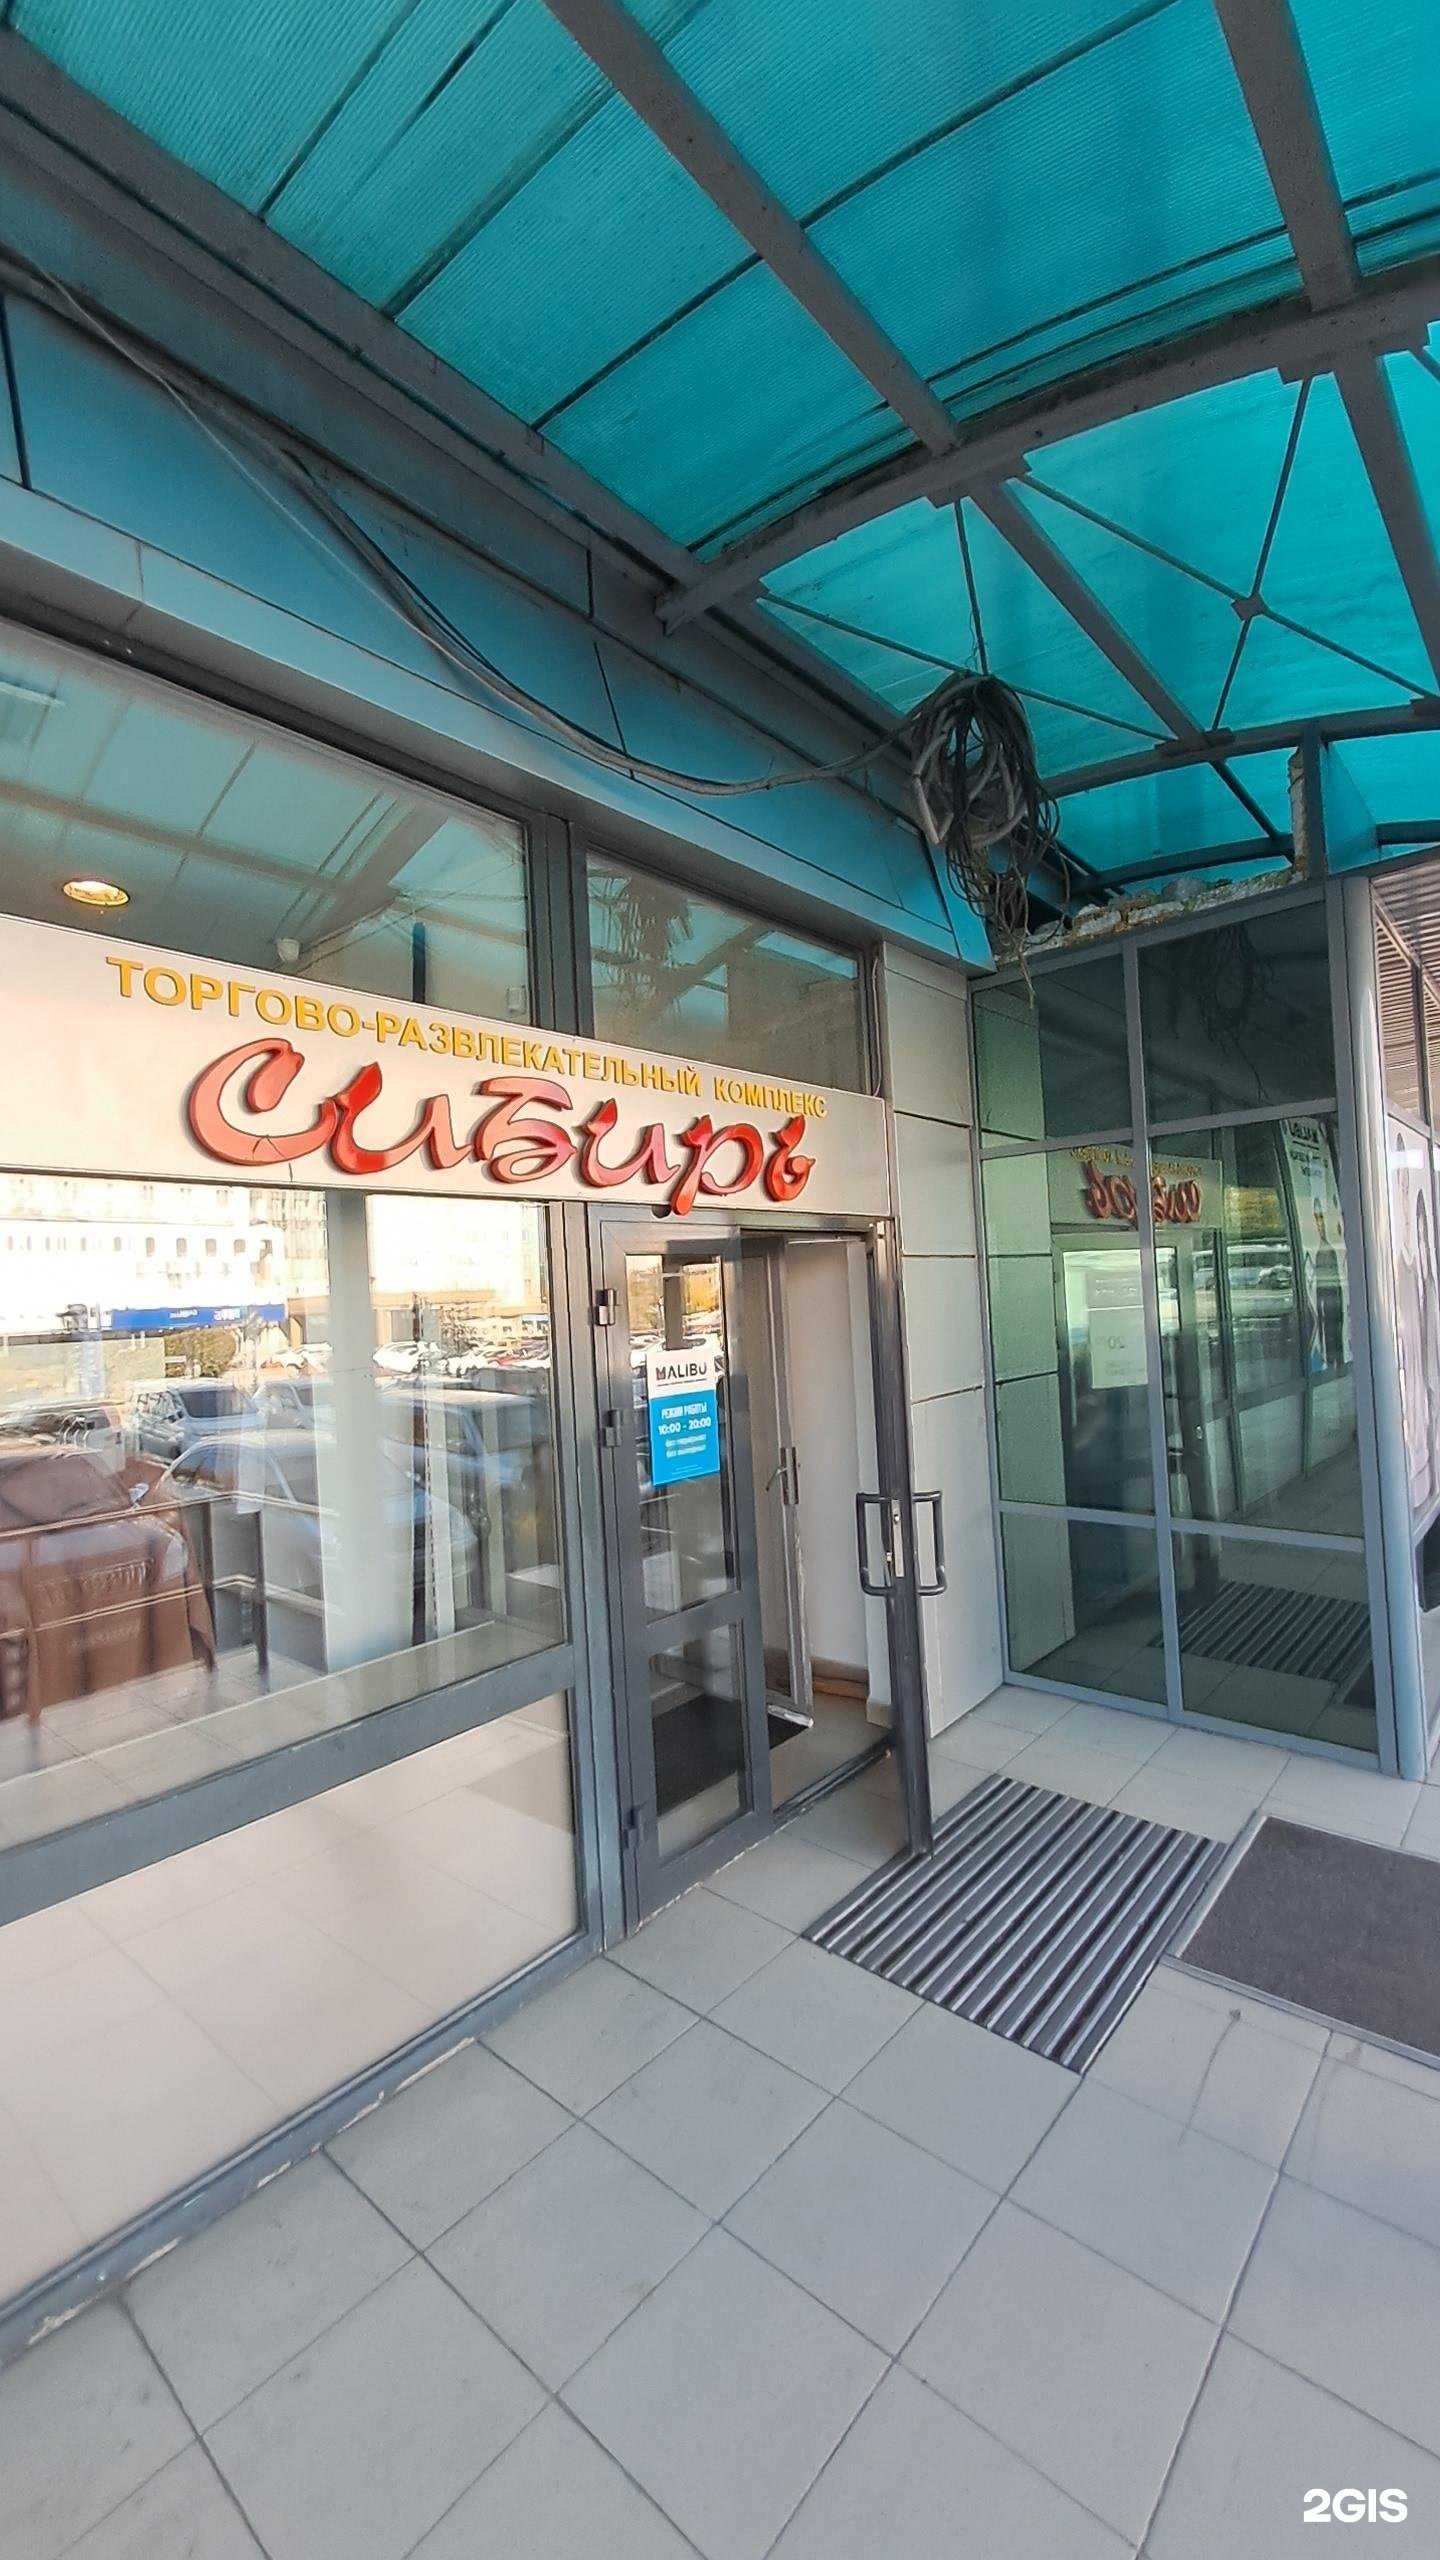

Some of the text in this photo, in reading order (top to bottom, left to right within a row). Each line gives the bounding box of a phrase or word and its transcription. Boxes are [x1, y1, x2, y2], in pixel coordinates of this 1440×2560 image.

[106, 956, 828, 1119] ТОРГОВО-РАЗВЛЕКАТЕЛЬНЫЙ КОМПЛЕКС
[655, 1362, 707, 1380] MALIBU
[658, 1422, 681, 1435] 10:00
[689, 1417, 712, 1430] 20:00
